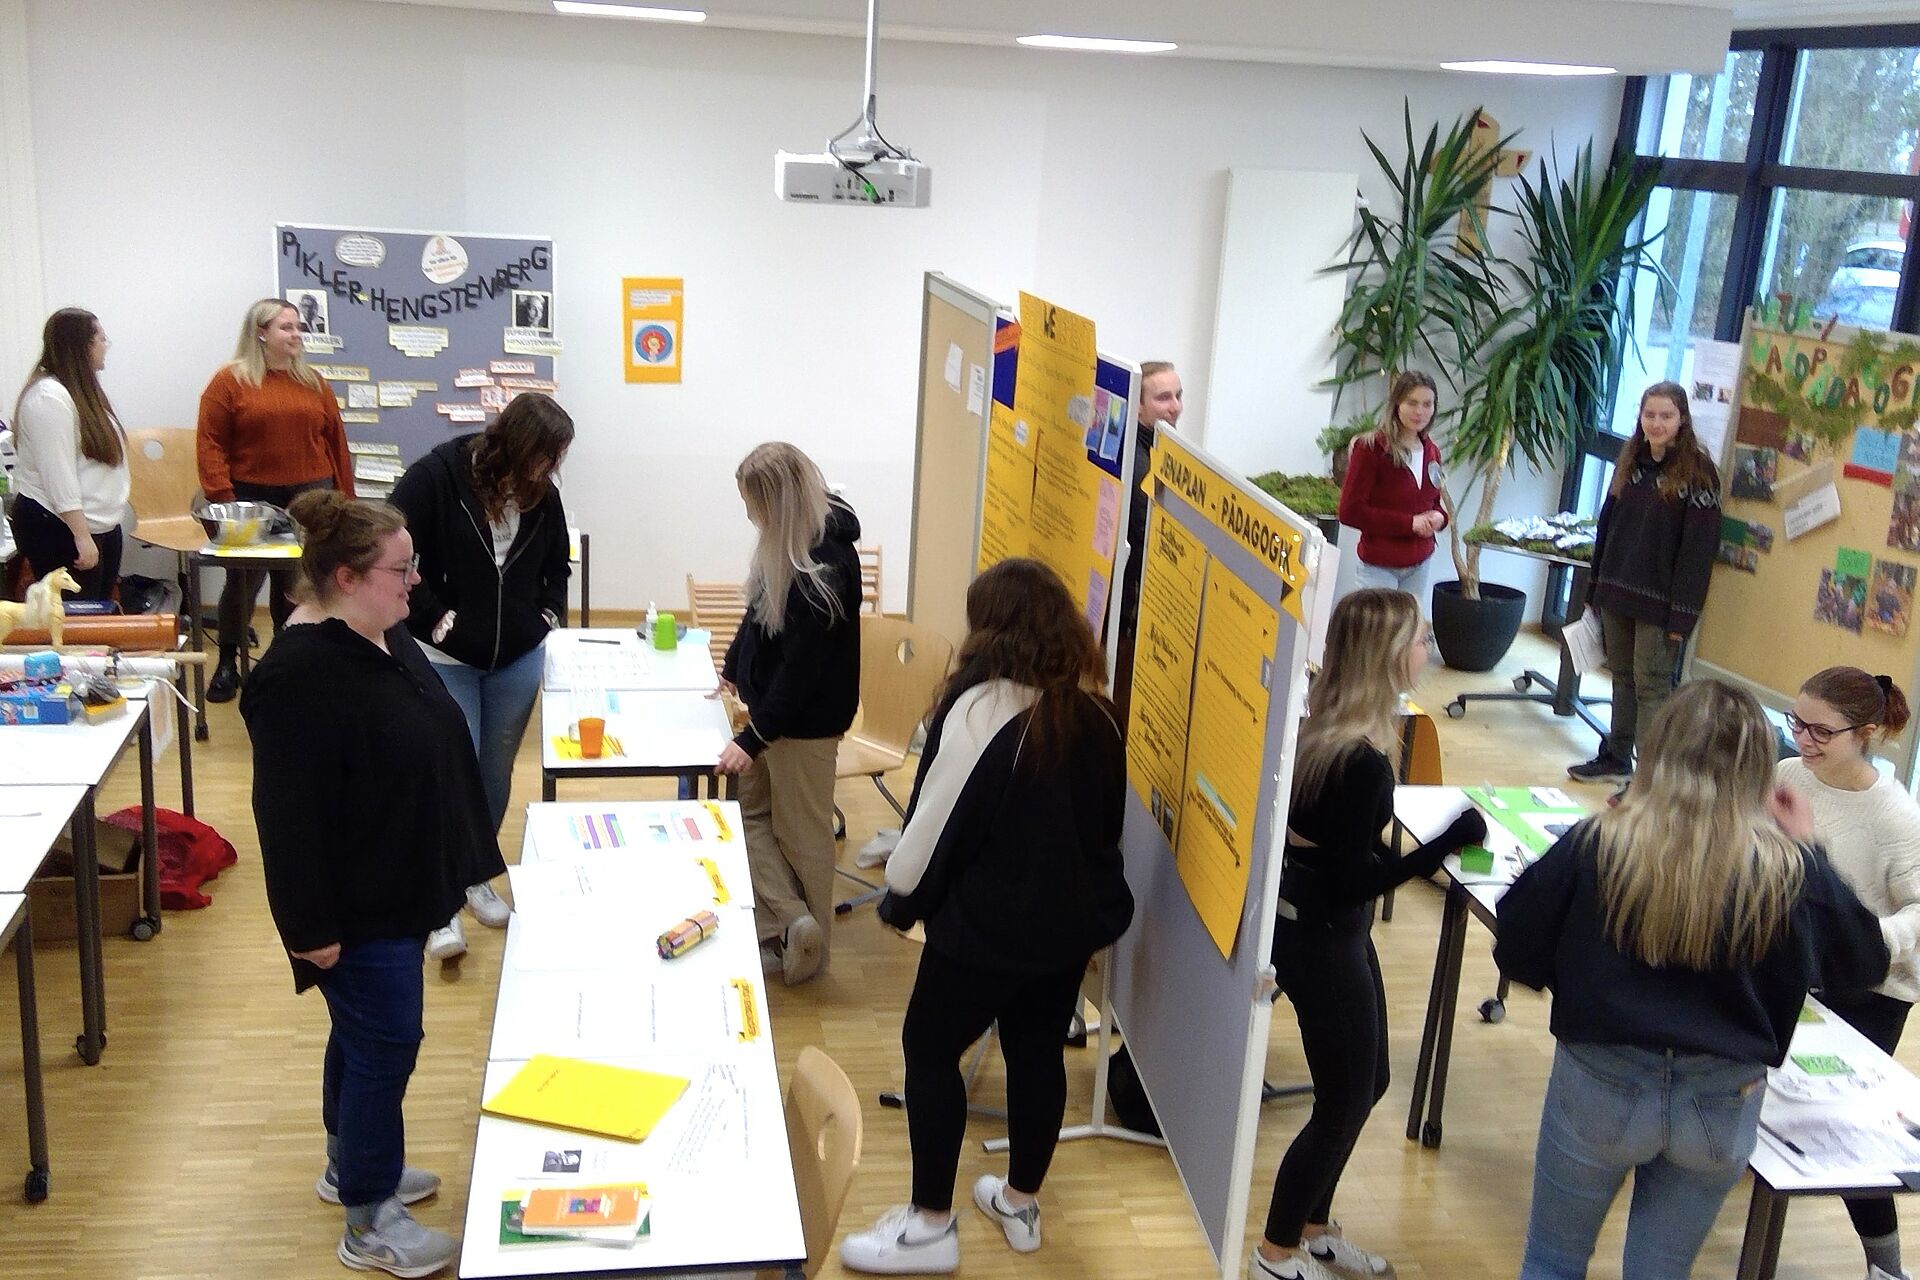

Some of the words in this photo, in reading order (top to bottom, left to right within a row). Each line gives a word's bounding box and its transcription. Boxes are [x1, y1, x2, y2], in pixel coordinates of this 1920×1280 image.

[282, 231, 363, 305] PIKLER
[370, 246, 548, 324] HENGSTENBERG
[1160, 451, 1207, 510] JENAPLAN
[1220, 493, 1293, 576] PÄDAGOGIK
